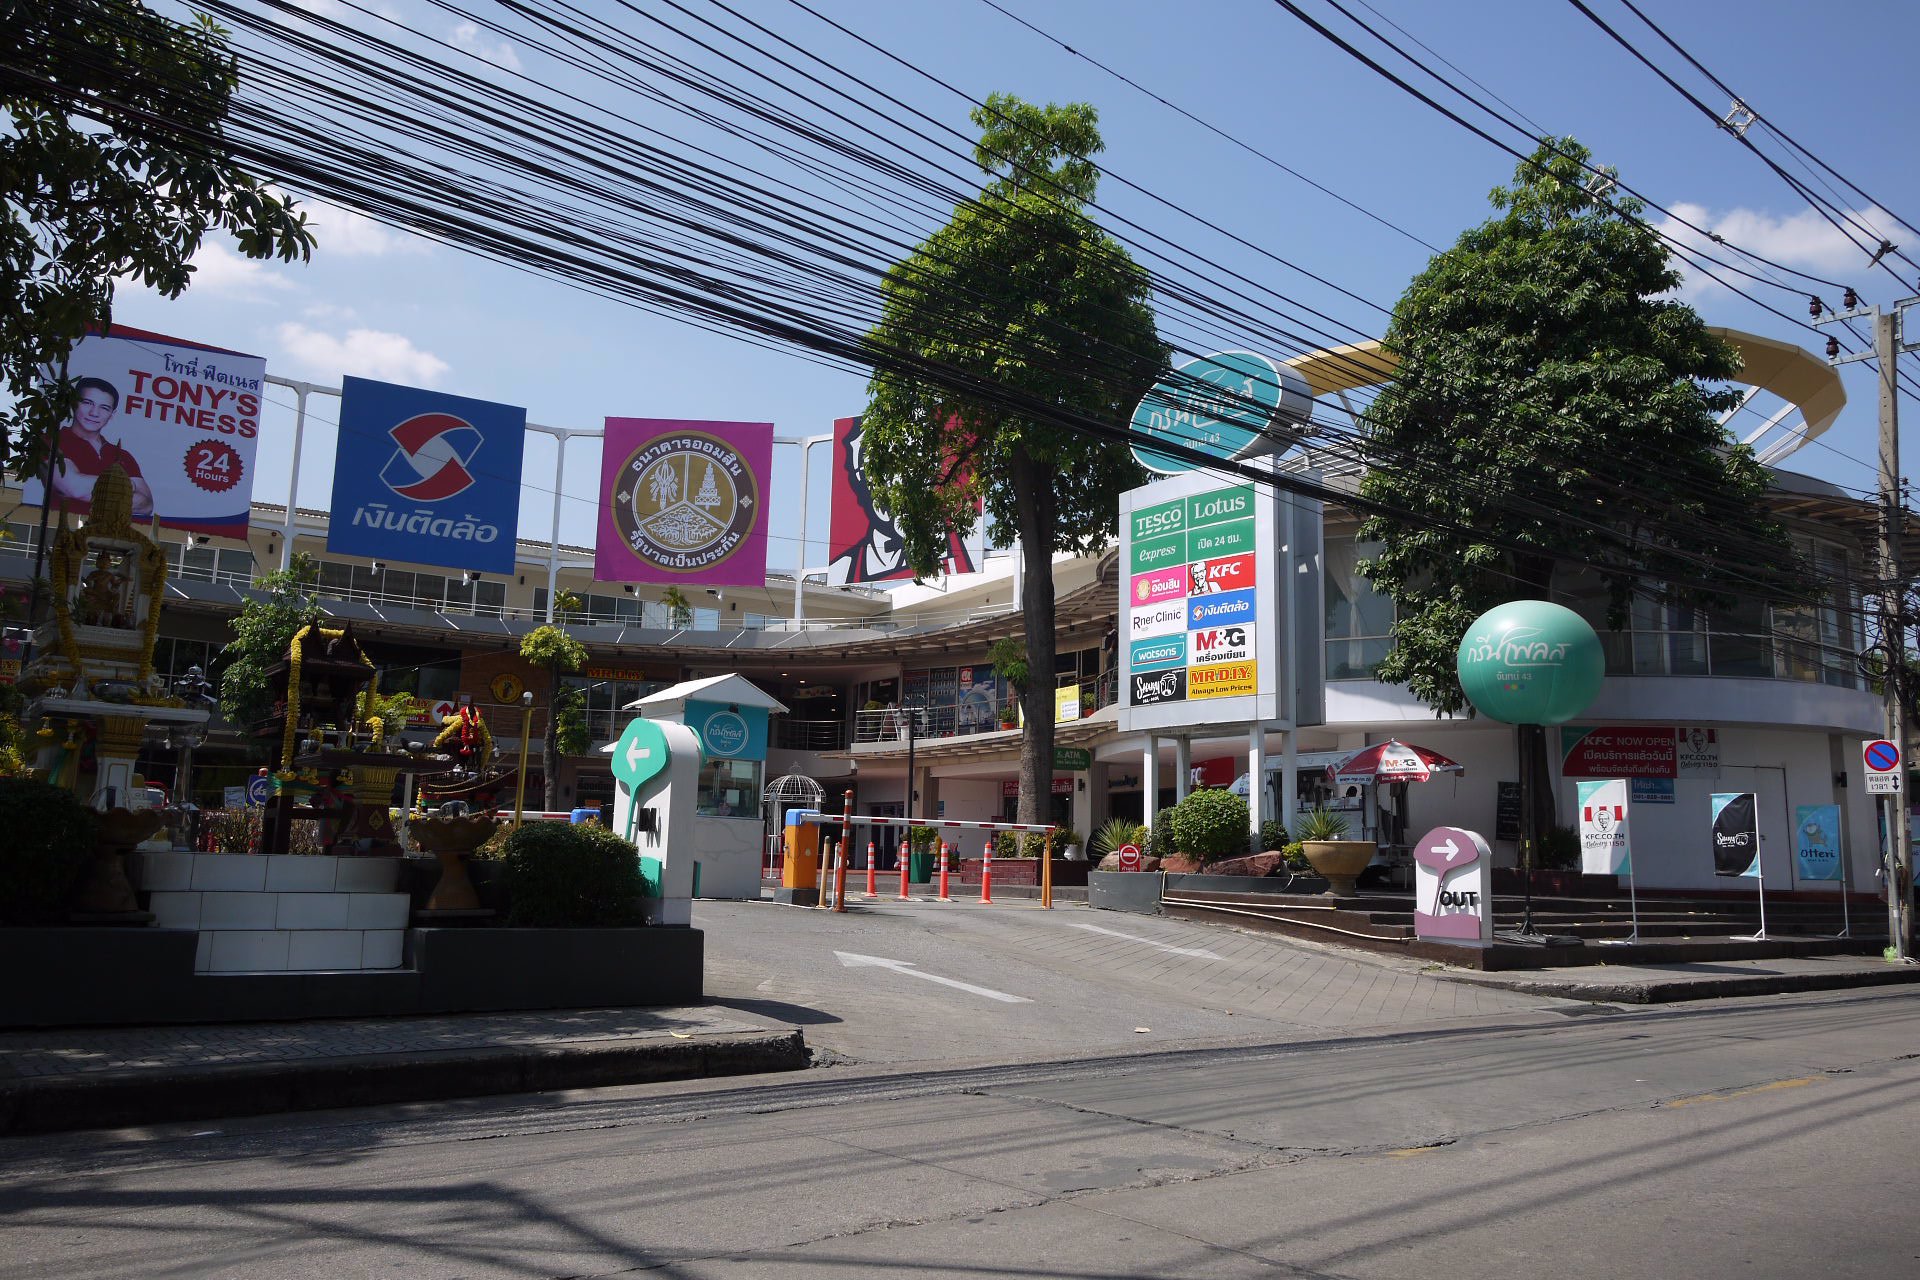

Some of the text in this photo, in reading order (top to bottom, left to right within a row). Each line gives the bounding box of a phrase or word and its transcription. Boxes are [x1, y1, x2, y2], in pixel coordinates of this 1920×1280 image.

[164, 353, 198, 377] โทนี่
[129, 369, 259, 417] TONY'S
[125, 395, 257, 439] FITNESS
[198, 449, 230, 473] 24
[632, 438, 743, 477] ธนาคารออมสิน
[195, 469, 230, 483] Hours
[1194, 495, 1246, 519] Lotus
[352, 503, 498, 543] เงินติดล้อ
[1136, 508, 1182, 531] TESCO
[630, 529, 741, 568] รัฐบาลเป็นประกัน
[1197, 535, 1213, 550] เปิด
[1215, 536, 1225, 547] 24
[1139, 545, 1177, 563] express
[1209, 561, 1241, 579] KFC
[1152, 578, 1180, 593] ออมสิน
[1155, 609, 1182, 623] Clinic
[1204, 601, 1249, 616] เงินติดล้อ
[1196, 627, 1246, 651] M&G
[1138, 647, 1177, 660] watsons
[1196, 650, 1246, 663] เครื่องเขียน
[1191, 683, 1253, 695] Always Low Prices
[1583, 737, 1676, 747] KFC NOW OPEN
[1583, 748, 1673, 761] เปิดบริการแล้ววันนี้
[1800, 848, 1836, 858] Otteri
[1439, 891, 1478, 907] OUT
